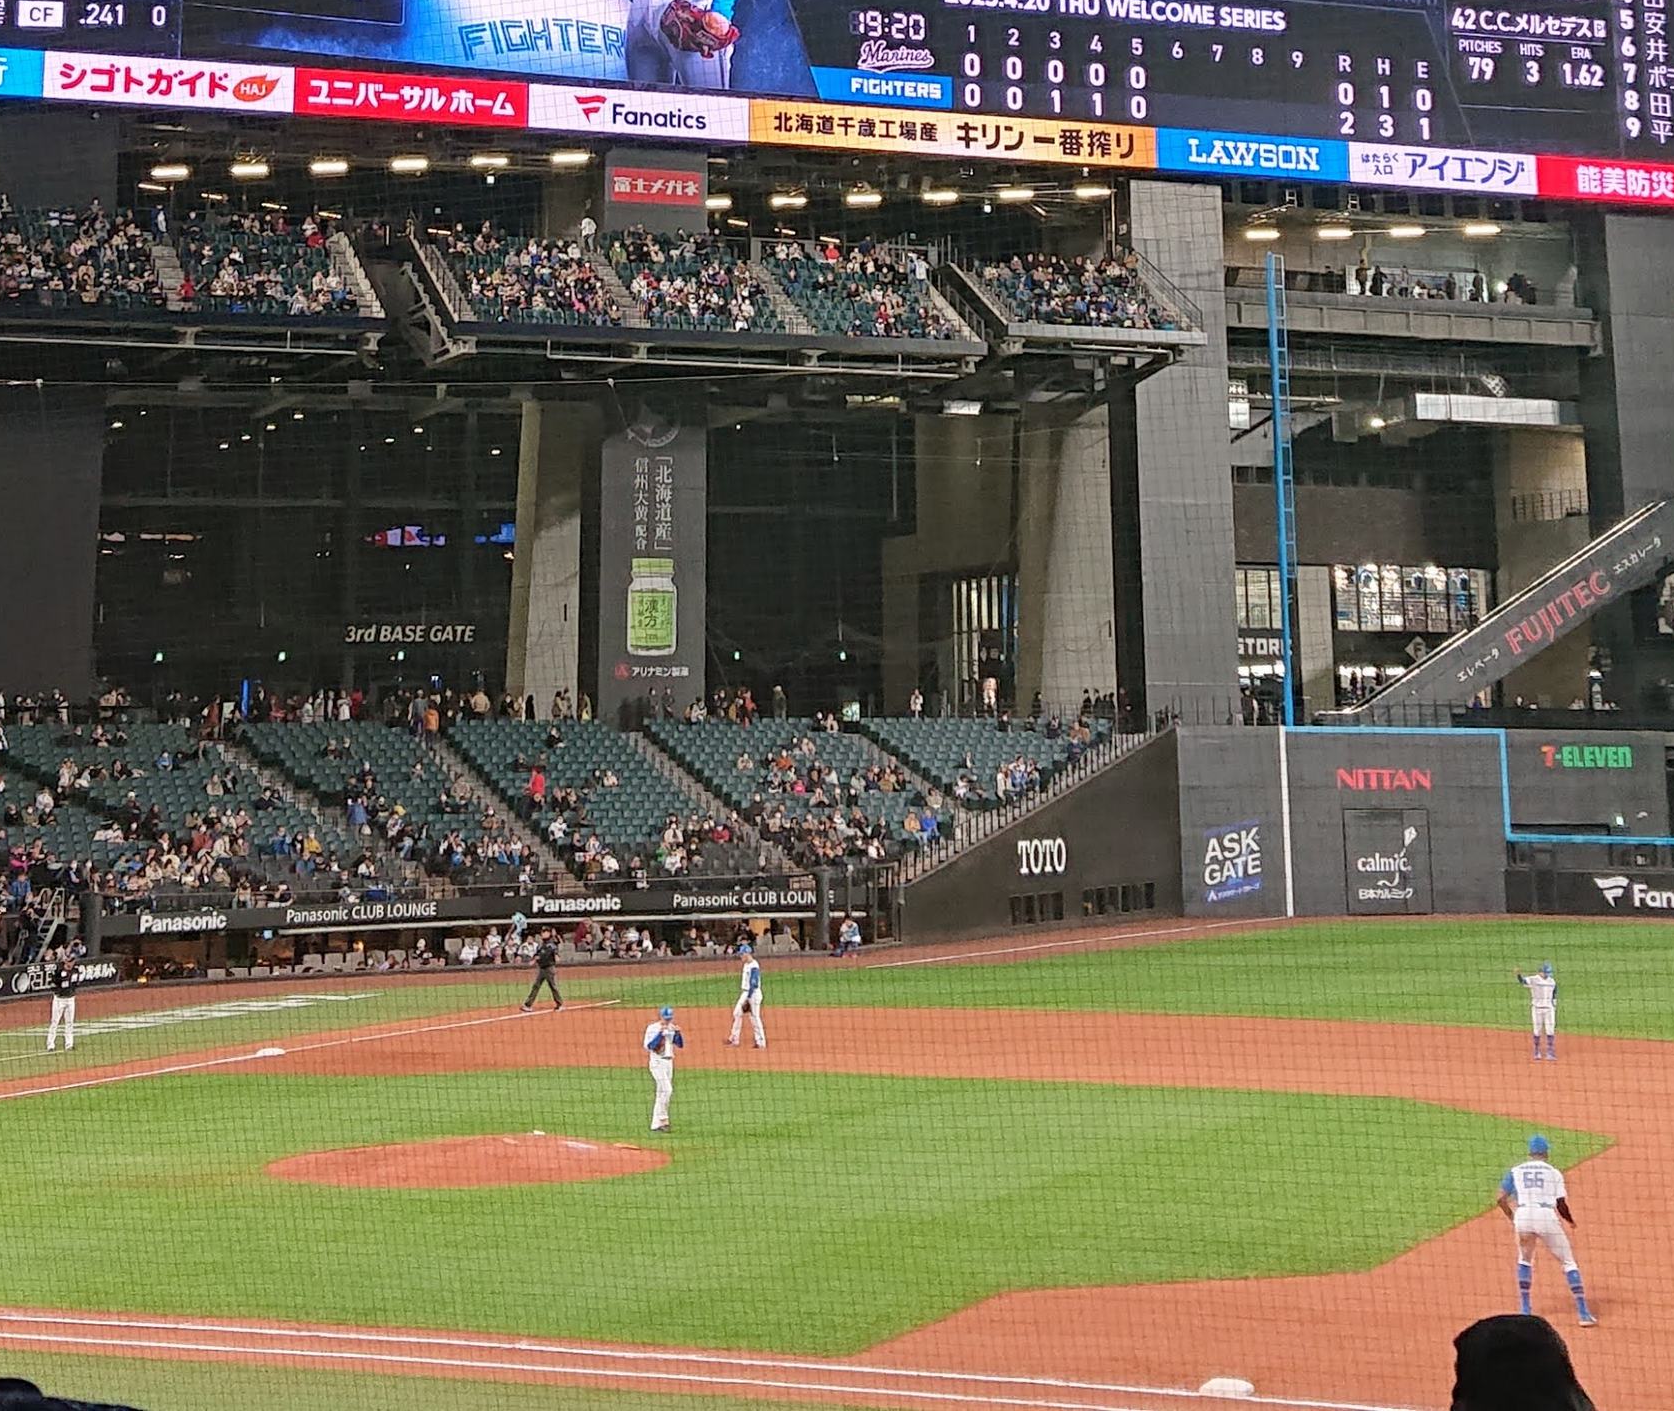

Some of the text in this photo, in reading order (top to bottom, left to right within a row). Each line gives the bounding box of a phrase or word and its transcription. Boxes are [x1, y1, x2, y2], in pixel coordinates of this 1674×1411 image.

[78, 3, 124, 26] .241
[857, 10, 926, 40] 19:20
[1219, 7, 1287, 31] SERIES
[1451, 7, 1477, 30] 42
[857, 39, 935, 74] Marines
[1458, 39, 1503, 54] PITCHES
[59, 63, 267, 99] シゴトガイド HAJ
[1468, 57, 1604, 87] 79 1.62
[851, 77, 941, 100] FIGHTERS
[612, 102, 707, 132] Fanatics
[773, 113, 939, 143] 北海道千歳工場産
[1187, 138, 1321, 171] LAWSON
[1404, 152, 1528, 187] アイエンジ
[614, 177, 699, 196] 富士メガネ
[1504, 570, 1611, 655] FUJITEC
[345, 625, 475, 642] 3rd BASE GATE
[1336, 767, 1432, 790] NITTAN
[1017, 837, 1067, 875] TOTO
[1205, 827, 1260, 864] ASK
[1205, 853, 1262, 885] GATE
[286, 901, 438, 924] Panasonic CLUB LOUNGE
[532, 894, 622, 914] Panasonic
[673, 891, 777, 908] Panasonic CLUB
[140, 911, 227, 933] Panasonic
